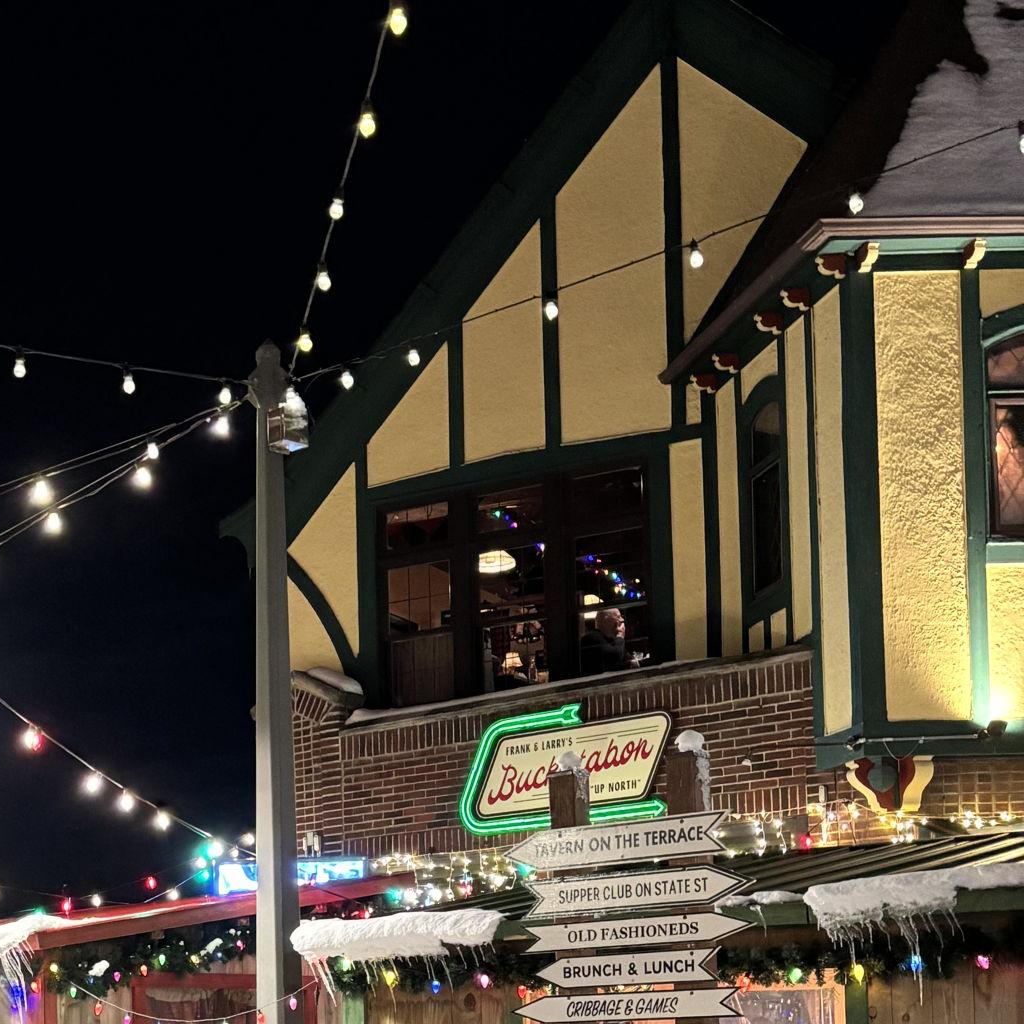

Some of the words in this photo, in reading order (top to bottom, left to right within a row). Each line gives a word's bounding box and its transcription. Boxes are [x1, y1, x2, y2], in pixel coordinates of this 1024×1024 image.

[506, 743, 531, 756] FRANK
[533, 742, 539, 752] &
[541, 737, 573, 750] LARRY'S
[487, 738, 654, 805] Buckabon
[535, 839, 584, 857] TAVERN
[589, 836, 611, 851] ON
[615, 833, 640, 849] THE
[643, 825, 704, 846] TERRACE
[558, 887, 600, 904] SUPPER
[603, 885, 632, 901] CLUB
[635, 882, 652, 898] ON
[654, 879, 691, 897] STATE
[694, 877, 708, 893] ST
[567, 929, 597, 943] OLD
[601, 921, 699, 940] FASHIONEDS
[563, 963, 622, 979] BRUNCH
[627, 962, 638, 975] &
[644, 959, 695, 975] LUNCH
[566, 999, 622, 1018] CRIBBAGE
[624, 999, 633, 1016] &
[635, 997, 678, 1015] GAMES
